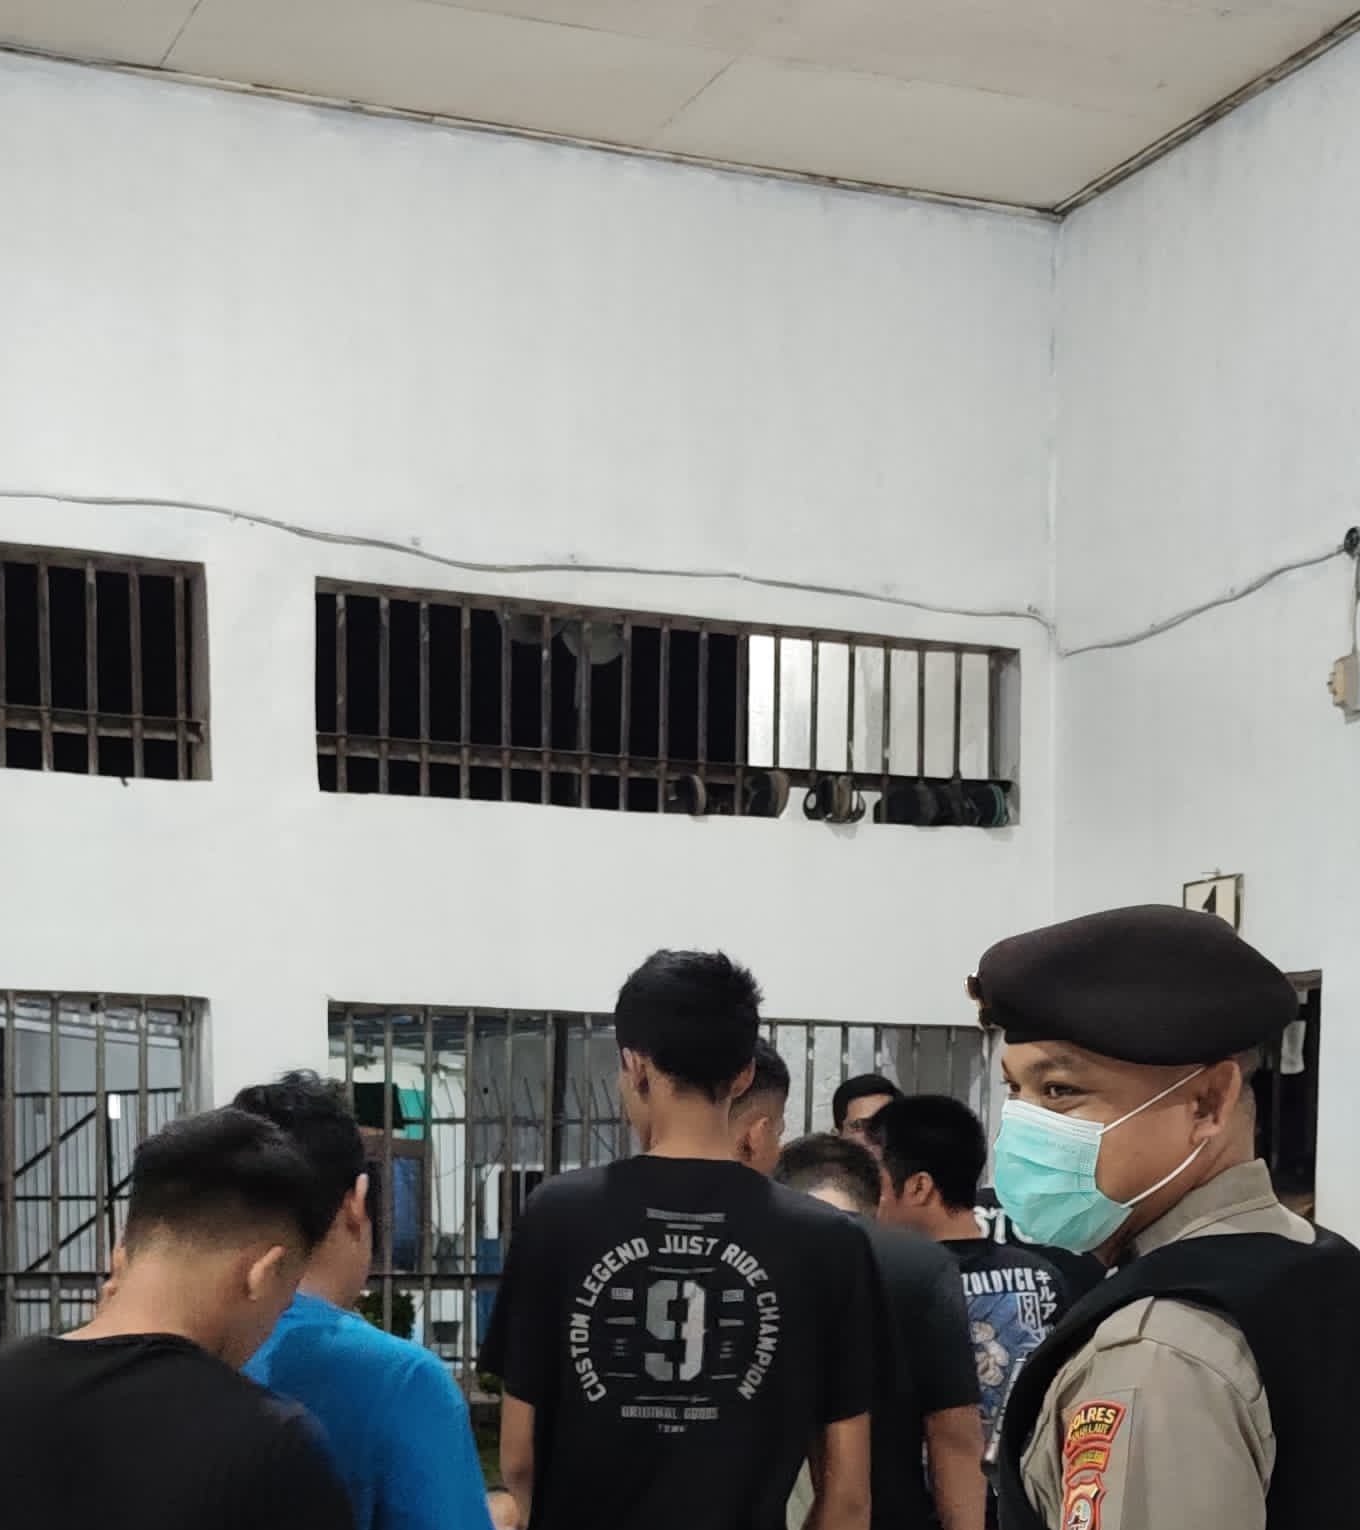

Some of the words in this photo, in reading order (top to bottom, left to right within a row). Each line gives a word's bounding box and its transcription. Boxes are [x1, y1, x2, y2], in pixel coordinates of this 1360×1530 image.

[576, 1237, 650, 1308] LEGEND
[658, 1234, 720, 1257] JUST
[721, 1243, 769, 1288] RIDE
[961, 1267, 1037, 1297] ZOLDYCK
[570, 1312, 607, 1402] CUSTOM
[644, 1279, 706, 1382] 9
[737, 1291, 781, 1400] CHAMPION
